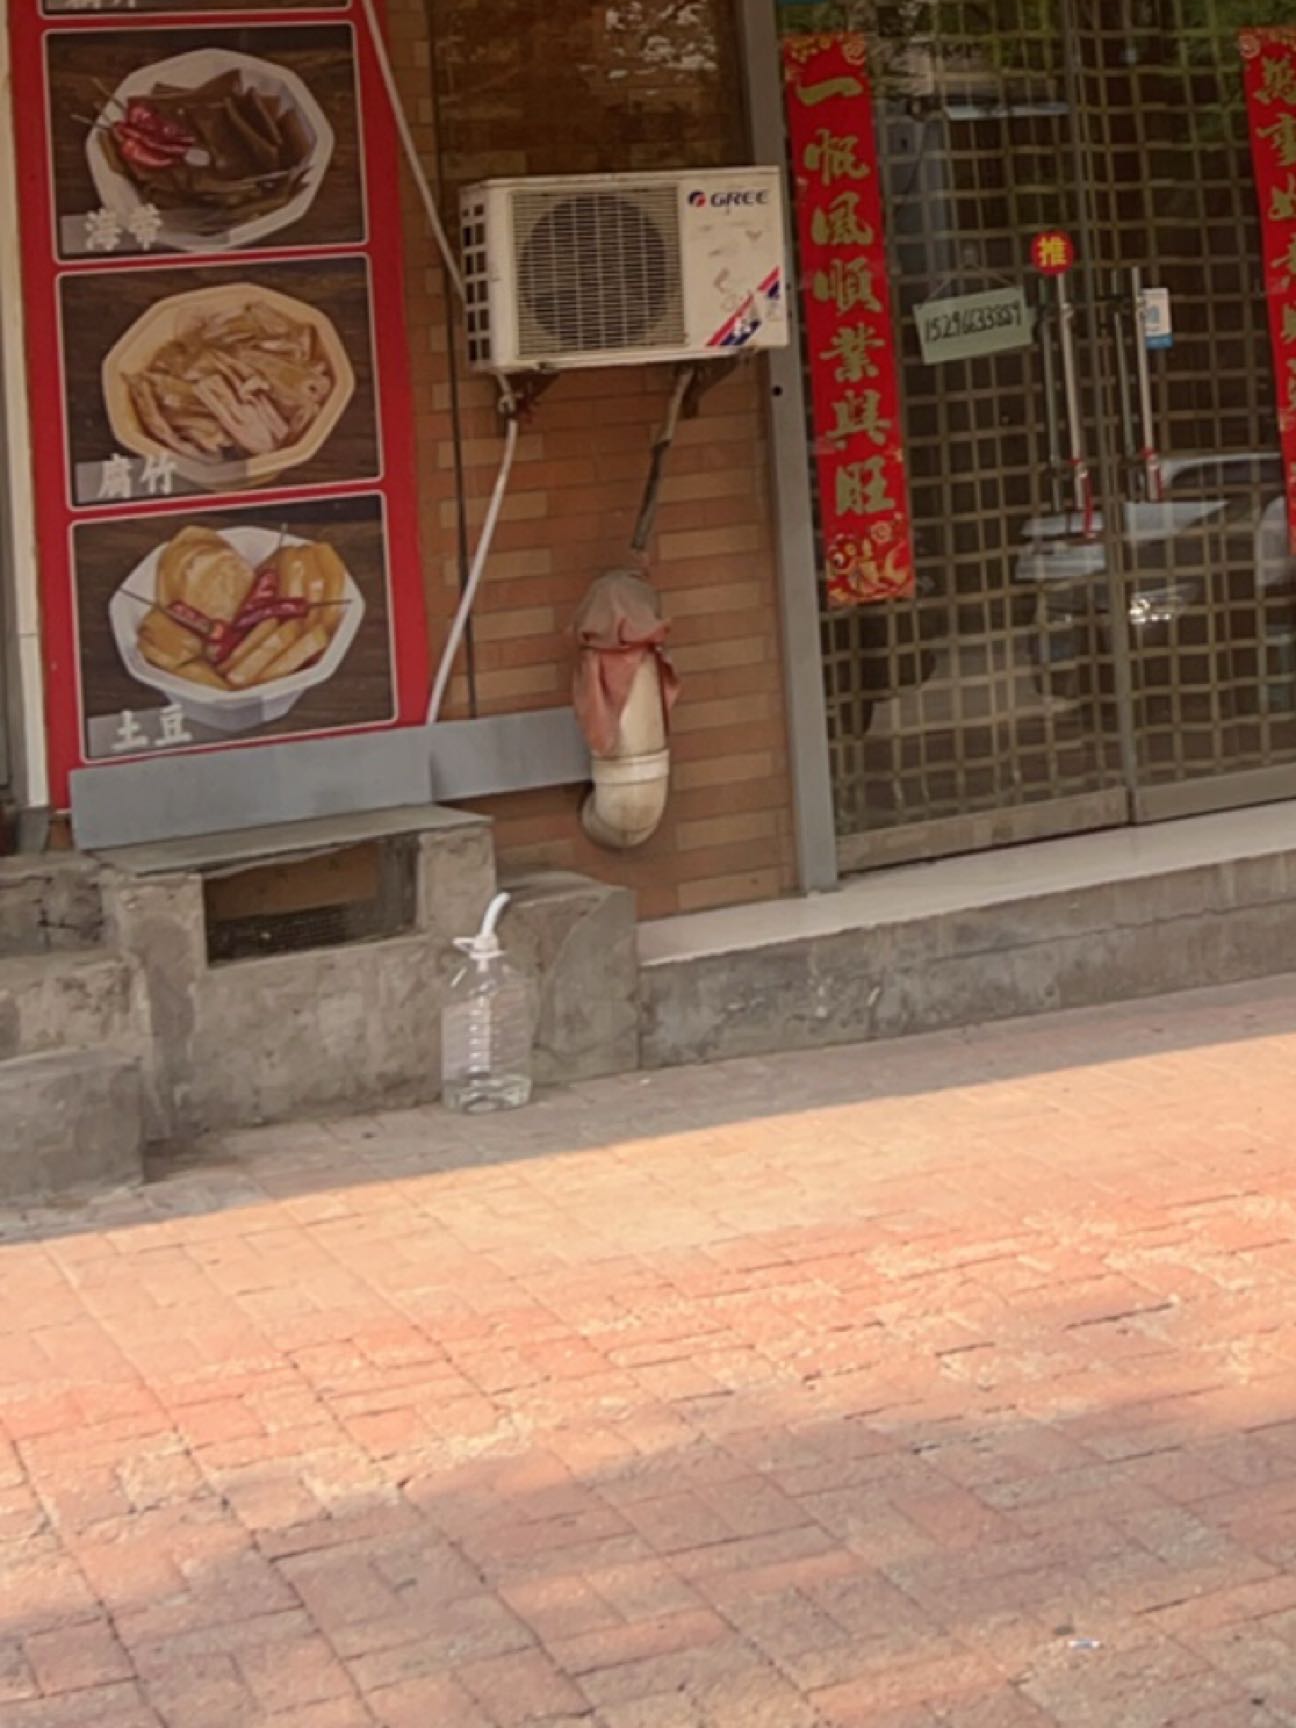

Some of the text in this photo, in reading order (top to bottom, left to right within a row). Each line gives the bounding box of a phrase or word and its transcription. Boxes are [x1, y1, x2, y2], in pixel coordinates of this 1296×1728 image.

[1037, 235, 1068, 268] 推
[97, 453, 177, 499] 腐竹
[112, 704, 193, 752] 土豆
